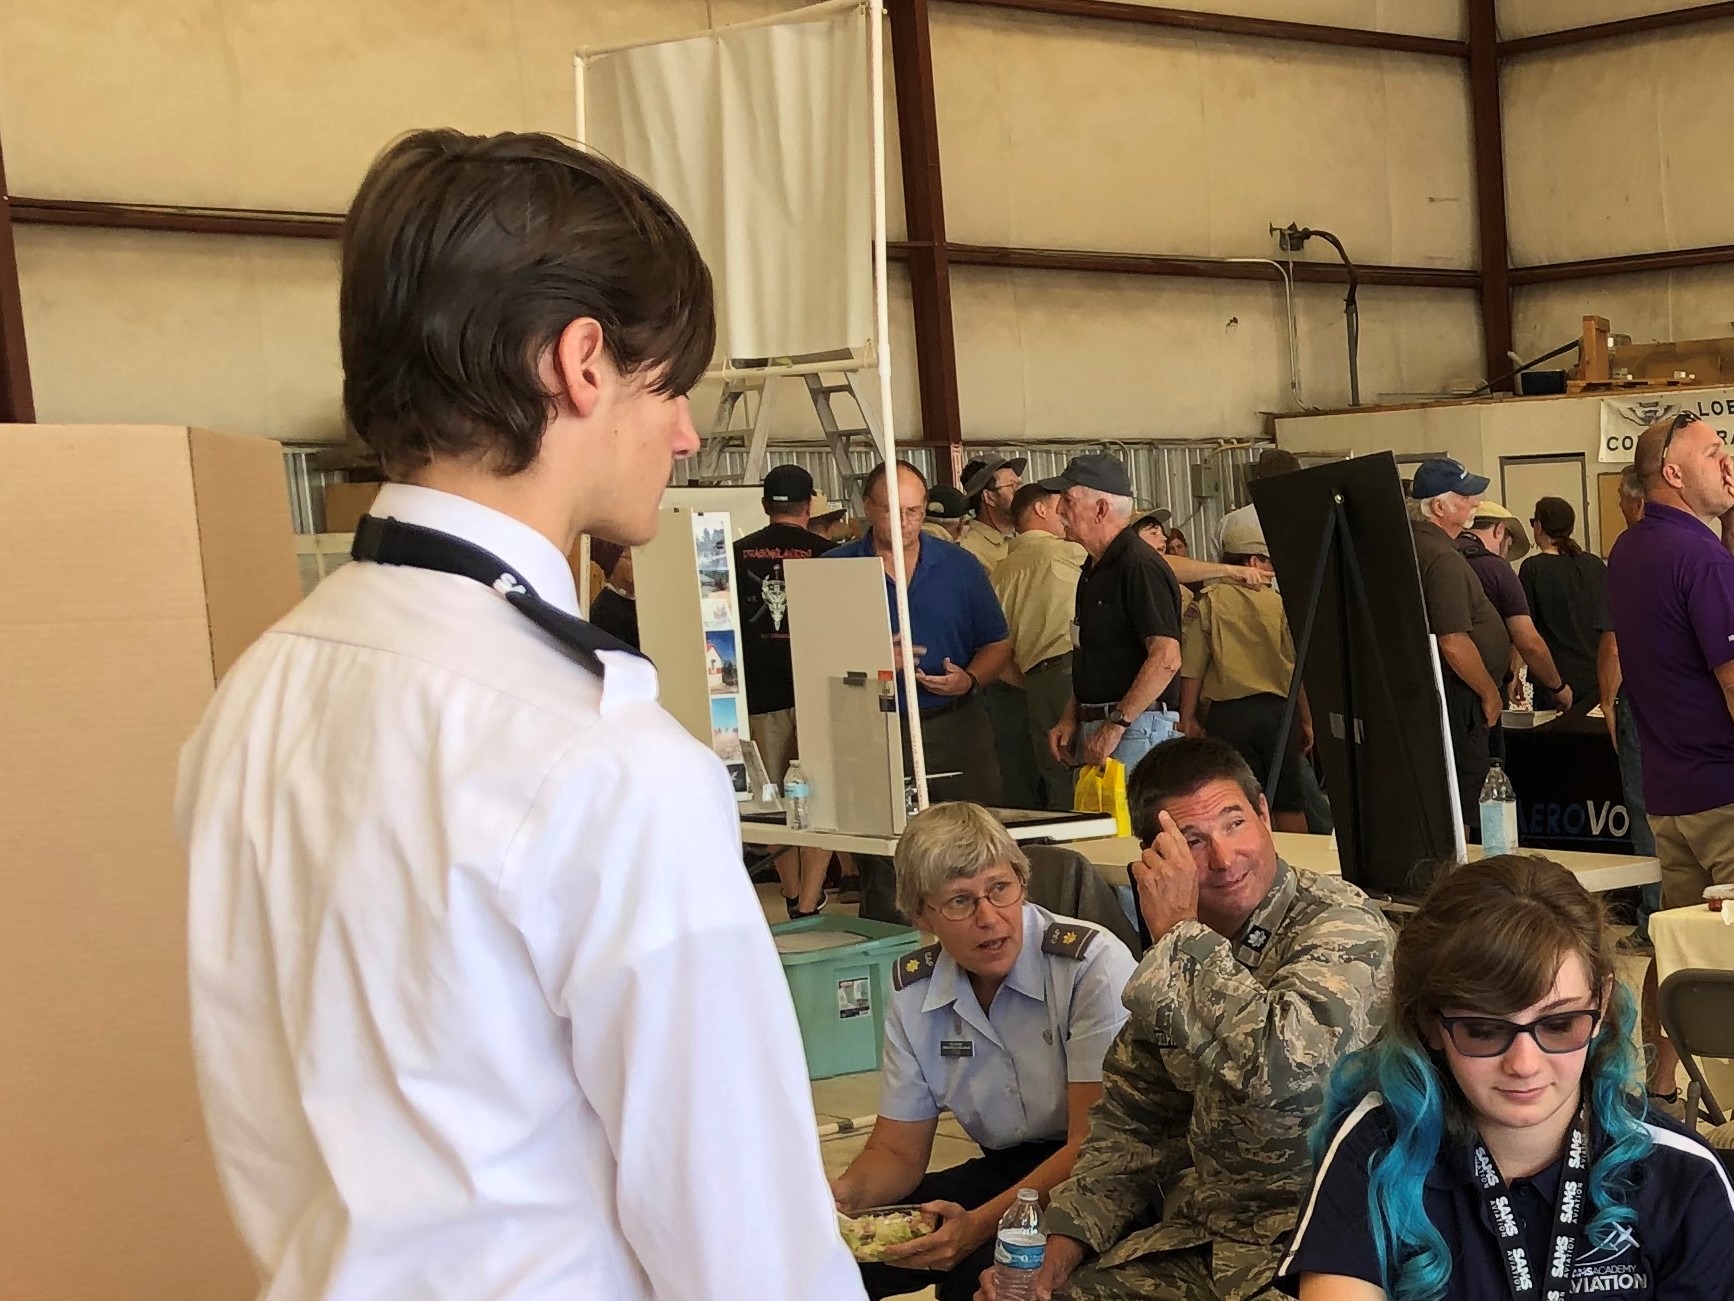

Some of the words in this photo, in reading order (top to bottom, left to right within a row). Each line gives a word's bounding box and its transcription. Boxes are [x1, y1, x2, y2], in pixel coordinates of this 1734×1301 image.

[1475, 1147, 1499, 1187] SAMS
[1568, 1129, 1582, 1169] SAMS
[1489, 1199, 1508, 1239] AVIATION
[1495, 1195, 1519, 1238] SAMS
[1559, 1180, 1578, 1225] SAMS
[1571, 1182, 1584, 1225] AVIATION
[1506, 1250, 1522, 1292] AVIATION
[1512, 1247, 1533, 1292] SAMS
[1551, 1235, 1569, 1279] SAMS
[1563, 1237, 1575, 1279] AVIATION
[1569, 1273, 1648, 1294] VIATION
